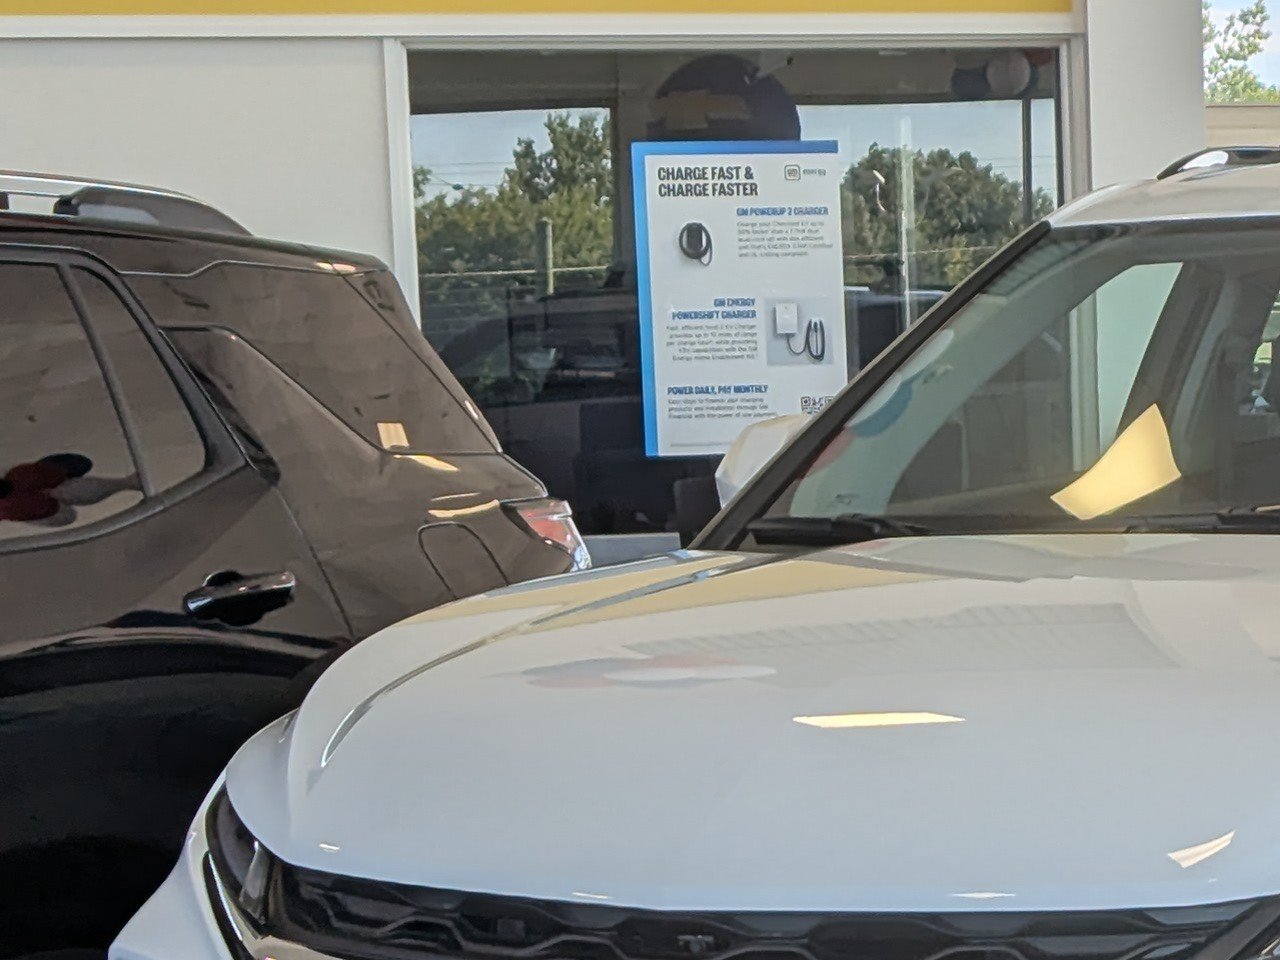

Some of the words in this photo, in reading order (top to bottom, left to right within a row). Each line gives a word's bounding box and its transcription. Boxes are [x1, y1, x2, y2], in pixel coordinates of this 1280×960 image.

[657, 167, 709, 181] CHARGE
[712, 166, 741, 180] FAST
[744, 166, 754, 180] &
[658, 184, 709, 197] CHARGE
[712, 182, 759, 197] FASTER
[787, 206, 793, 215] 2
[667, 386, 694, 395] POWER
